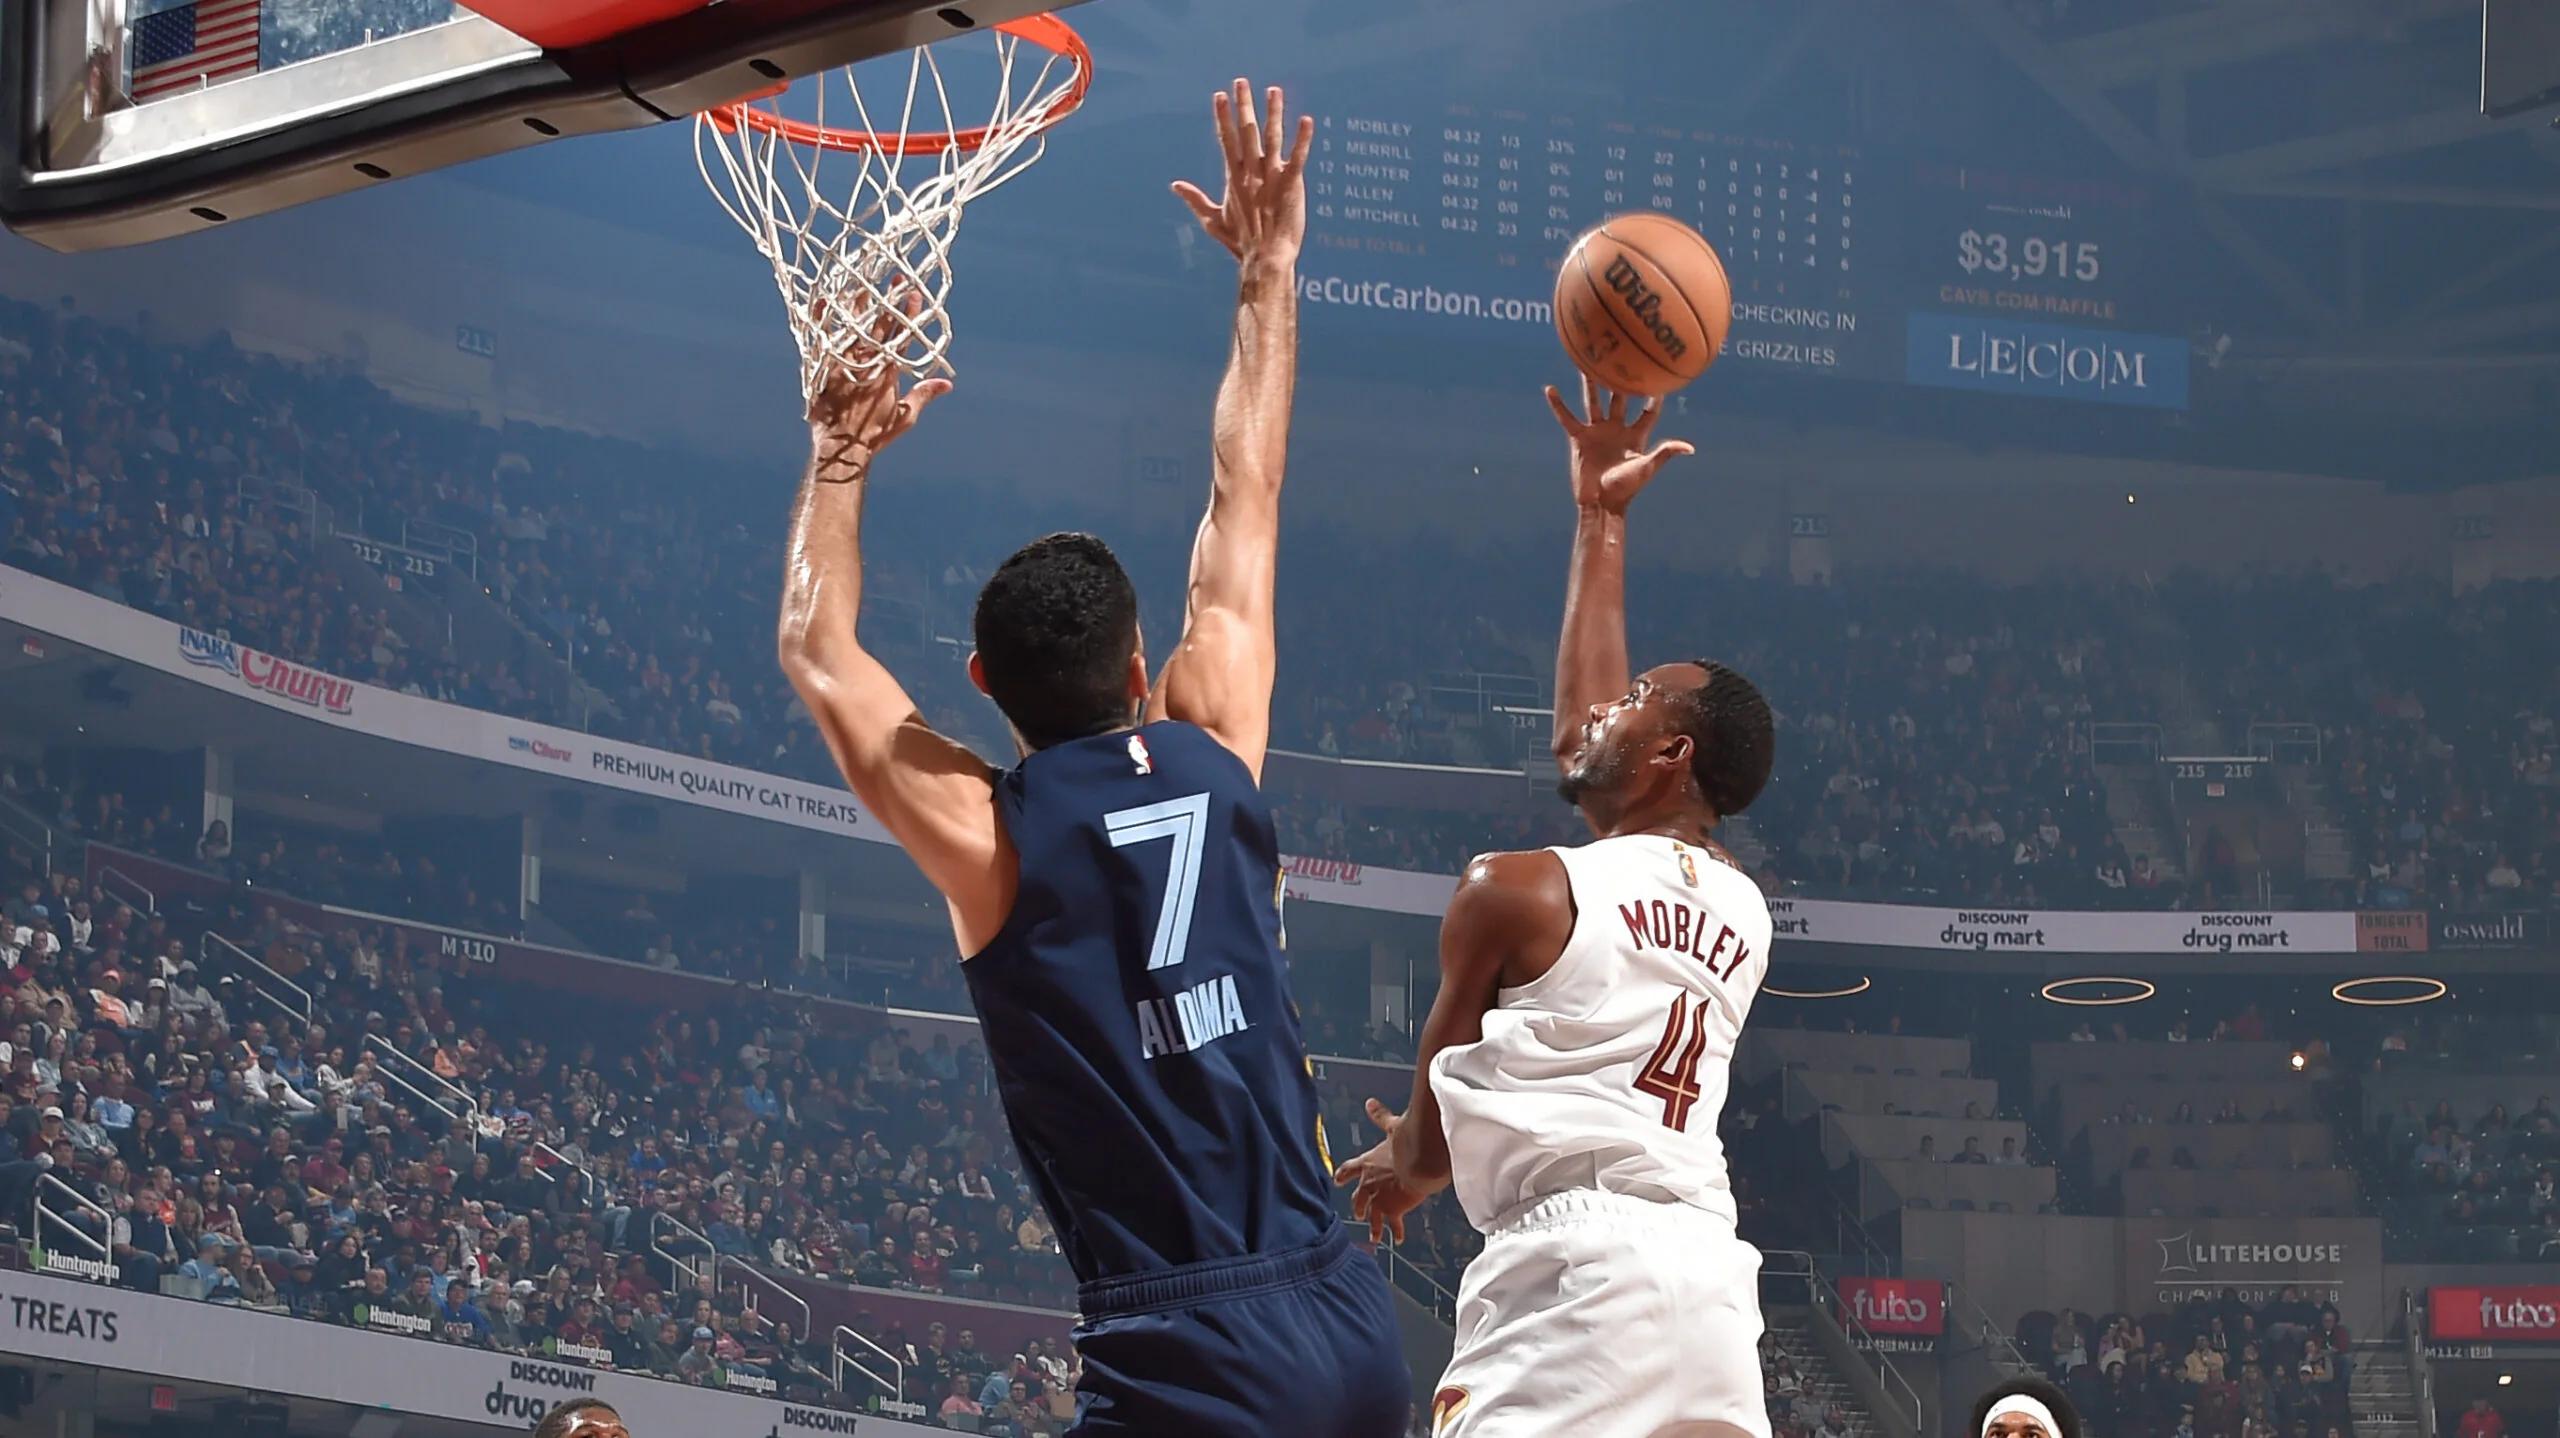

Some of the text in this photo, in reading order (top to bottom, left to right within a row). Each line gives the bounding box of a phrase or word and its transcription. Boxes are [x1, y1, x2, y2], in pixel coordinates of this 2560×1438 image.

[1347, 118, 1412, 136] MOBLEY
[1346, 141, 1412, 159] MERRILL
[1345, 163, 1410, 182] HUNTER
[1345, 184, 1394, 202] ALLEN
[1345, 207, 1420, 226] MITCHELL
[1957, 229, 2100, 282] $3,915
[1296, 275, 1551, 324] eCutCarbon.com
[1605, 253, 1686, 362] Wilson
[1732, 303, 1856, 331] CHECKING IN
[405, 556, 434, 576] 213
[593, 751, 858, 824] PREMIUM QUALITY CAT TREATS
[1103, 792, 1210, 971] 7
[1958, 913, 2029, 925] DISCOUNT
[2201, 915, 2272, 927] DISCOUNT
[2444, 915, 2524, 940] oswald
[442, 935, 456, 957] M
[1618, 899, 1749, 983] MOBLEY
[1940, 925, 2045, 950] drug mart
[2182, 928, 2289, 951] drug mart
[1137, 974, 1248, 1060] ALDMA
[1632, 987, 1711, 1133] 4
[48, 1248, 120, 1280] Huntington
[2196, 1245, 2341, 1263] LITEHOUSE
[370, 1304, 431, 1333] Huntington
[1854, 1288, 1927, 1322] fubo
[2480, 1296, 2556, 1329] fubo
[11, 1296, 118, 1343] TREATS
[556, 1338, 612, 1364] Huntington
[511, 1361, 596, 1392] DISCOUNT
[726, 1368, 777, 1392] Huntington
[784, 1407, 857, 1435] DISCOUNT
